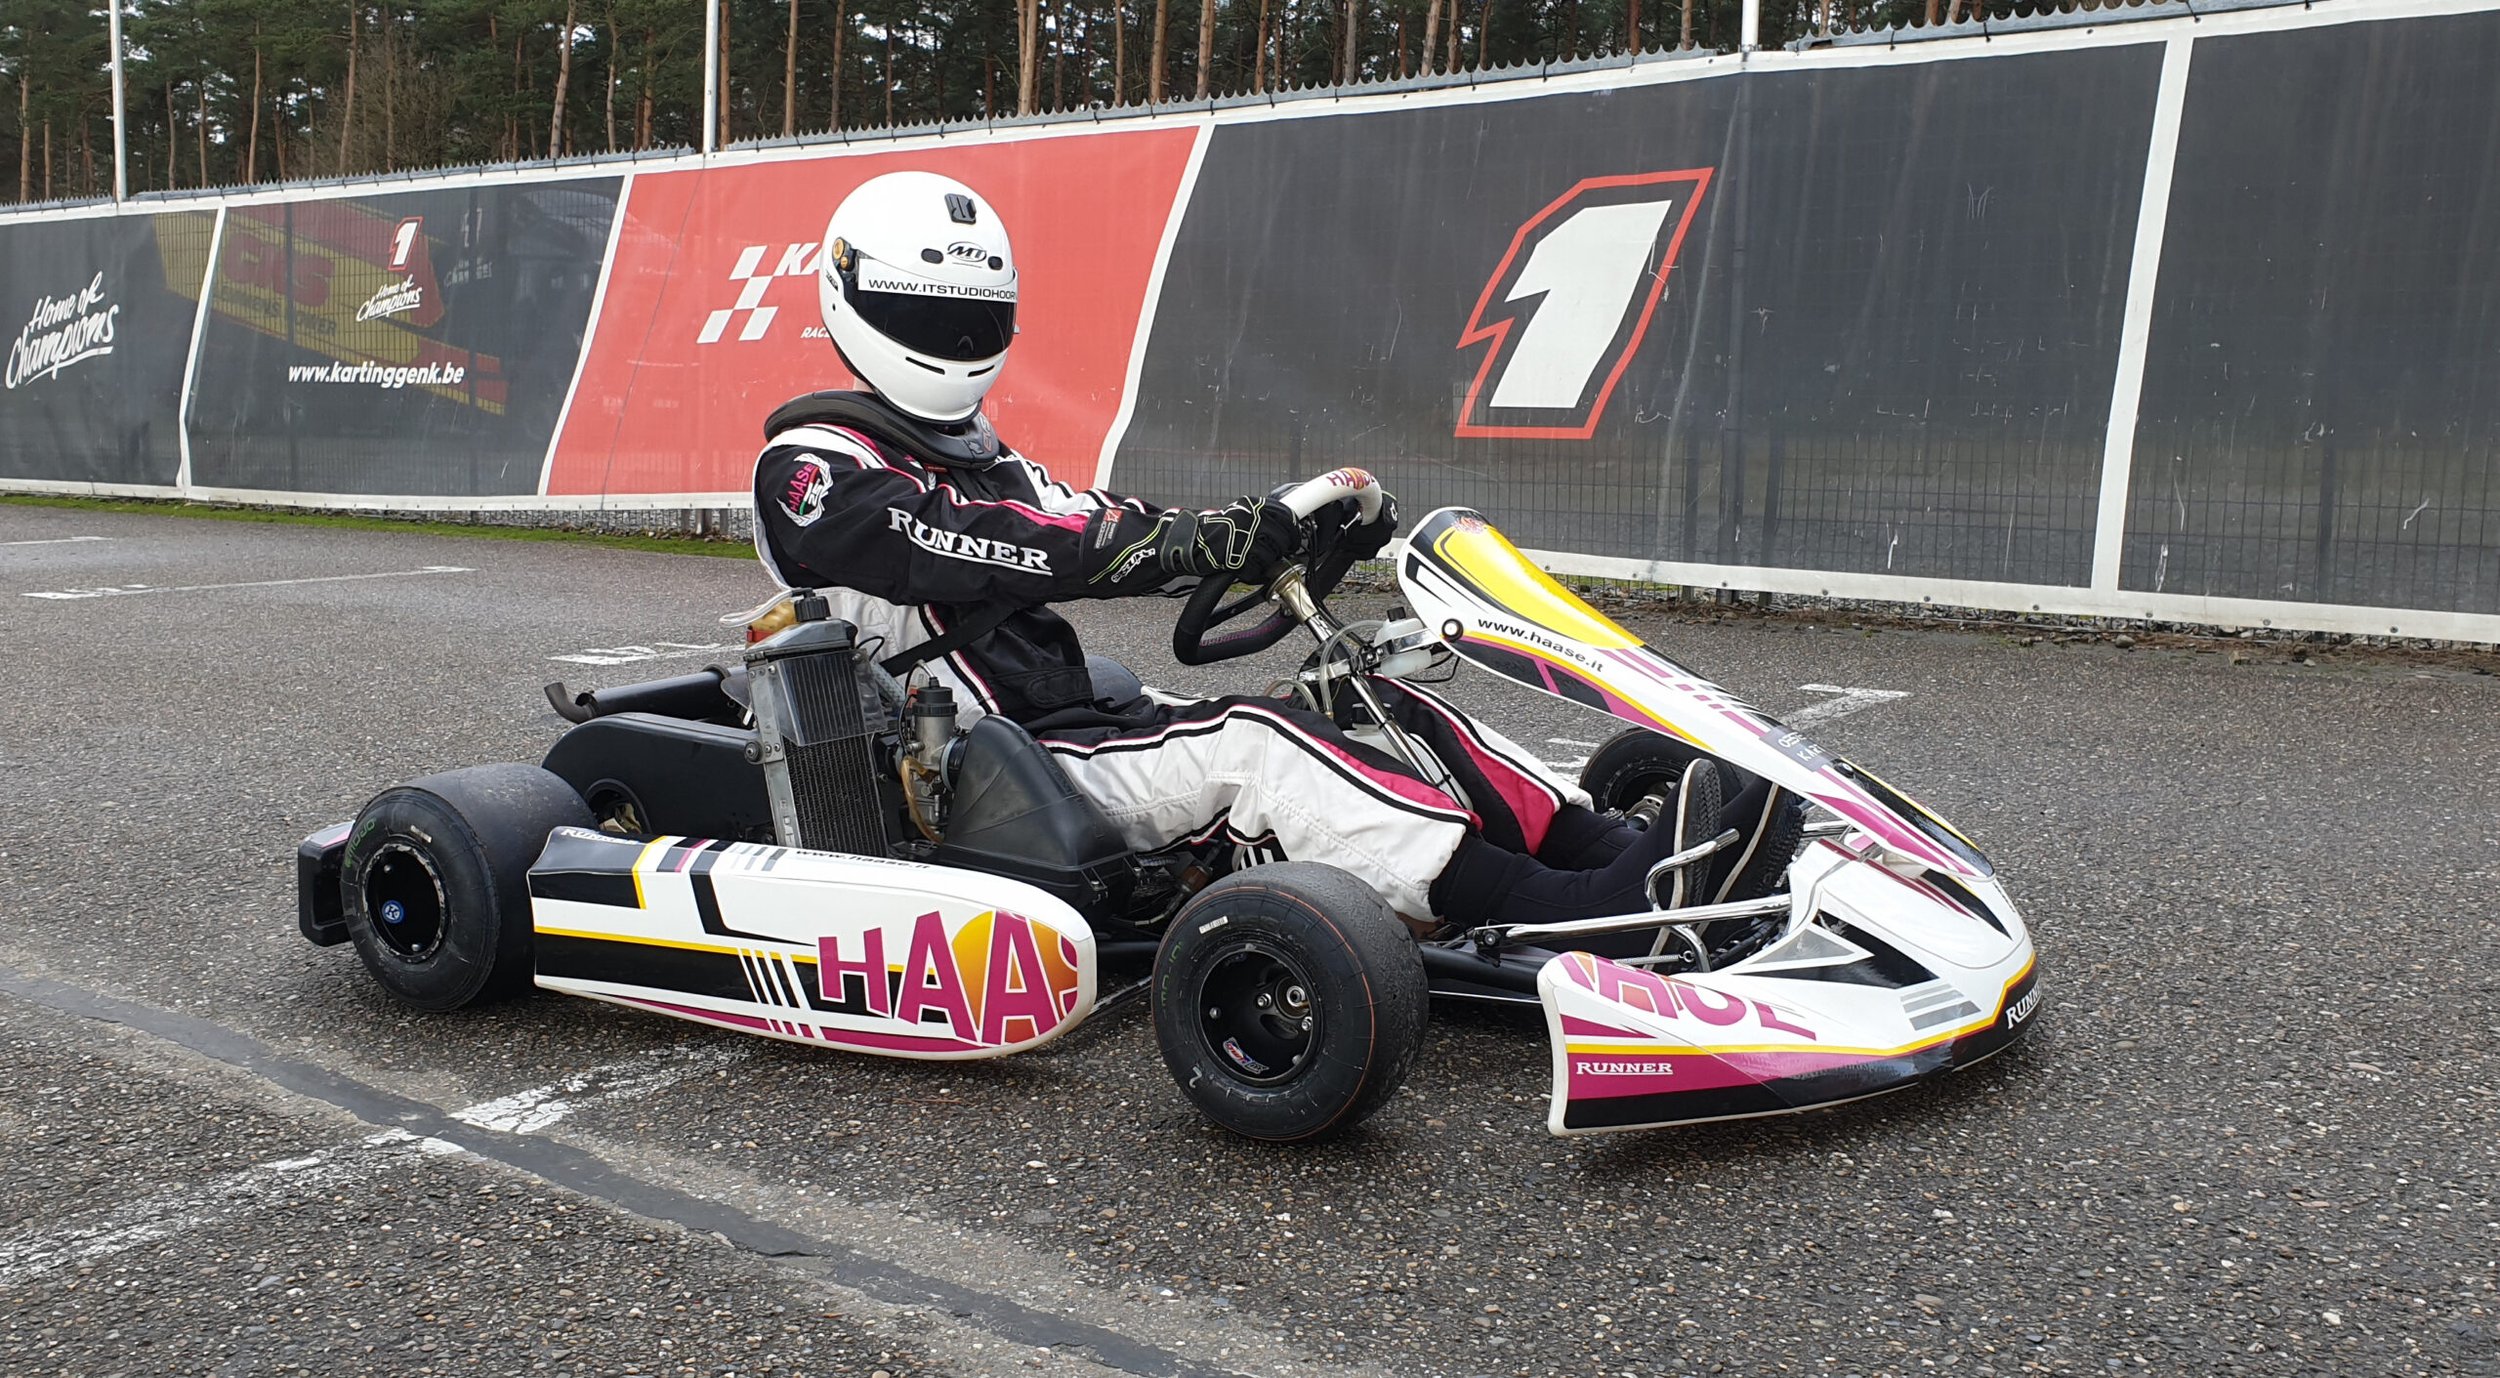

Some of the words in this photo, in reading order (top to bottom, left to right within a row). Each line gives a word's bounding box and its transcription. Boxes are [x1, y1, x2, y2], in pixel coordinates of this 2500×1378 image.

[392, 221, 419, 266] 1
[28, 295, 77, 333] Home
[77, 270, 105, 316] of
[356, 287, 423, 321] Champions
[376, 283, 400, 299] Home
[401, 273, 415, 290] of
[1489, 200, 1672, 408] 1
[5, 304, 120, 389] Champions
[288, 361, 465, 388] www.kartinggenk.be
[789, 463, 816, 512] HAASE
[887, 507, 1053, 575] RUNNER
[1477, 618, 1604, 673] www.haase.it
[1576, 1062, 1673, 1075] RUNNER
